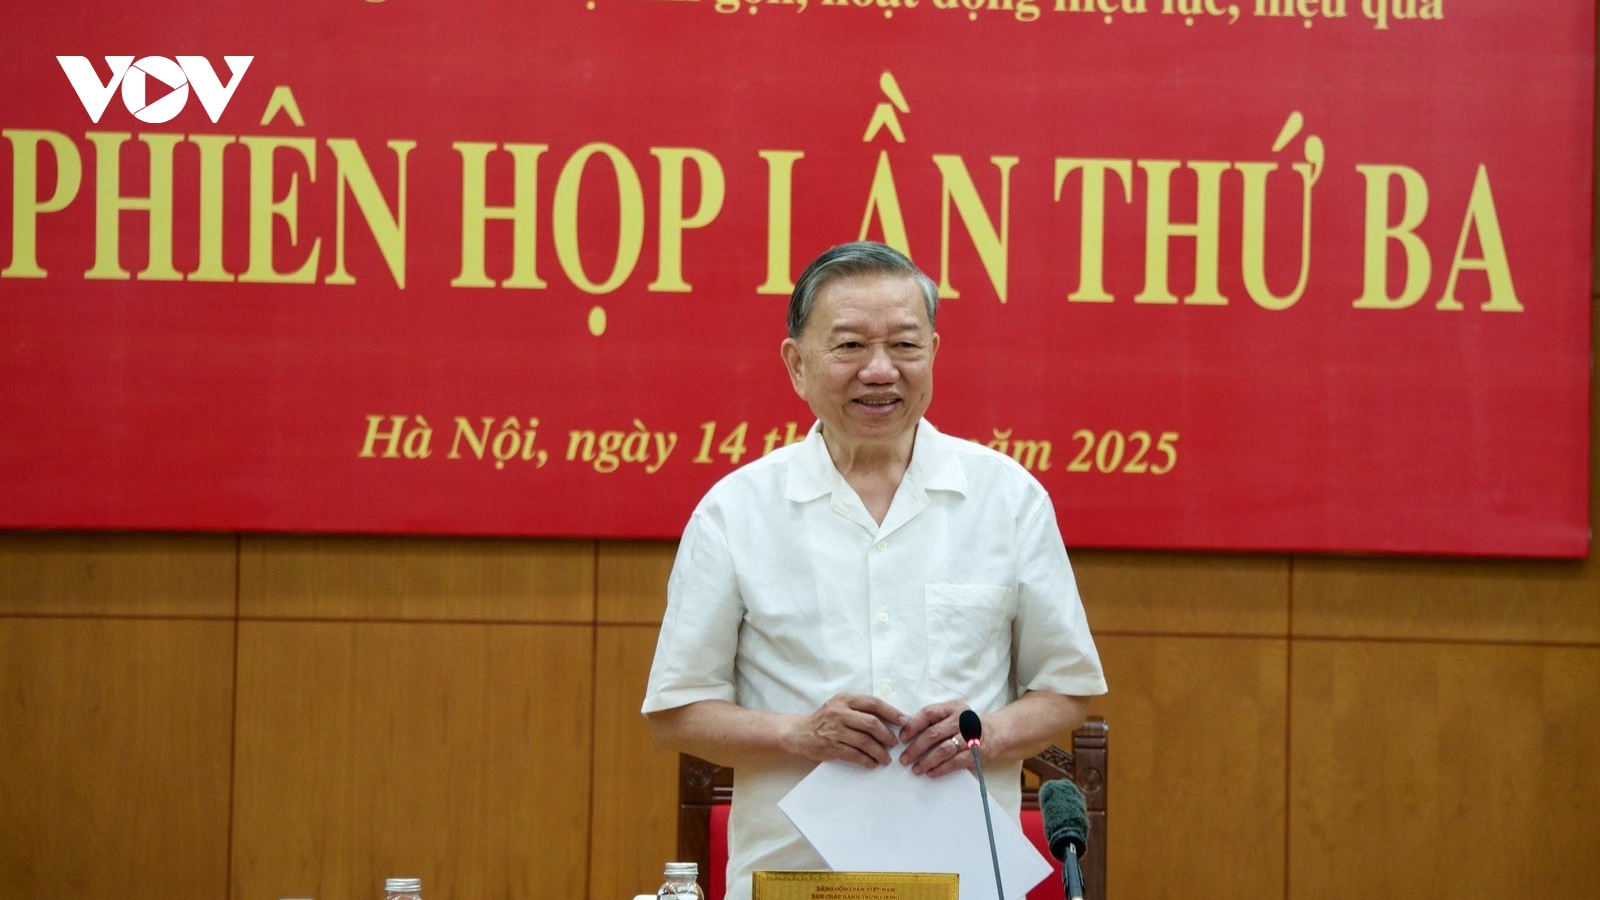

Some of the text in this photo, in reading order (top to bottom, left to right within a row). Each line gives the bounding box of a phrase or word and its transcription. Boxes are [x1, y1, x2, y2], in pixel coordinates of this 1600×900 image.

[1, 85, 417, 290] PHIÊN
[450, 141, 726, 337] HỌP
[1053, 111, 1325, 311] THỨ
[1352, 163, 1525, 313] BA
[360, 415, 433, 459] Hà
[448, 416, 548, 470] Nội,
[566, 419, 678, 474] ngày
[694, 421, 748, 464] 14
[969, 427, 1053, 472] ăm
[1067, 429, 1179, 475] 2025
